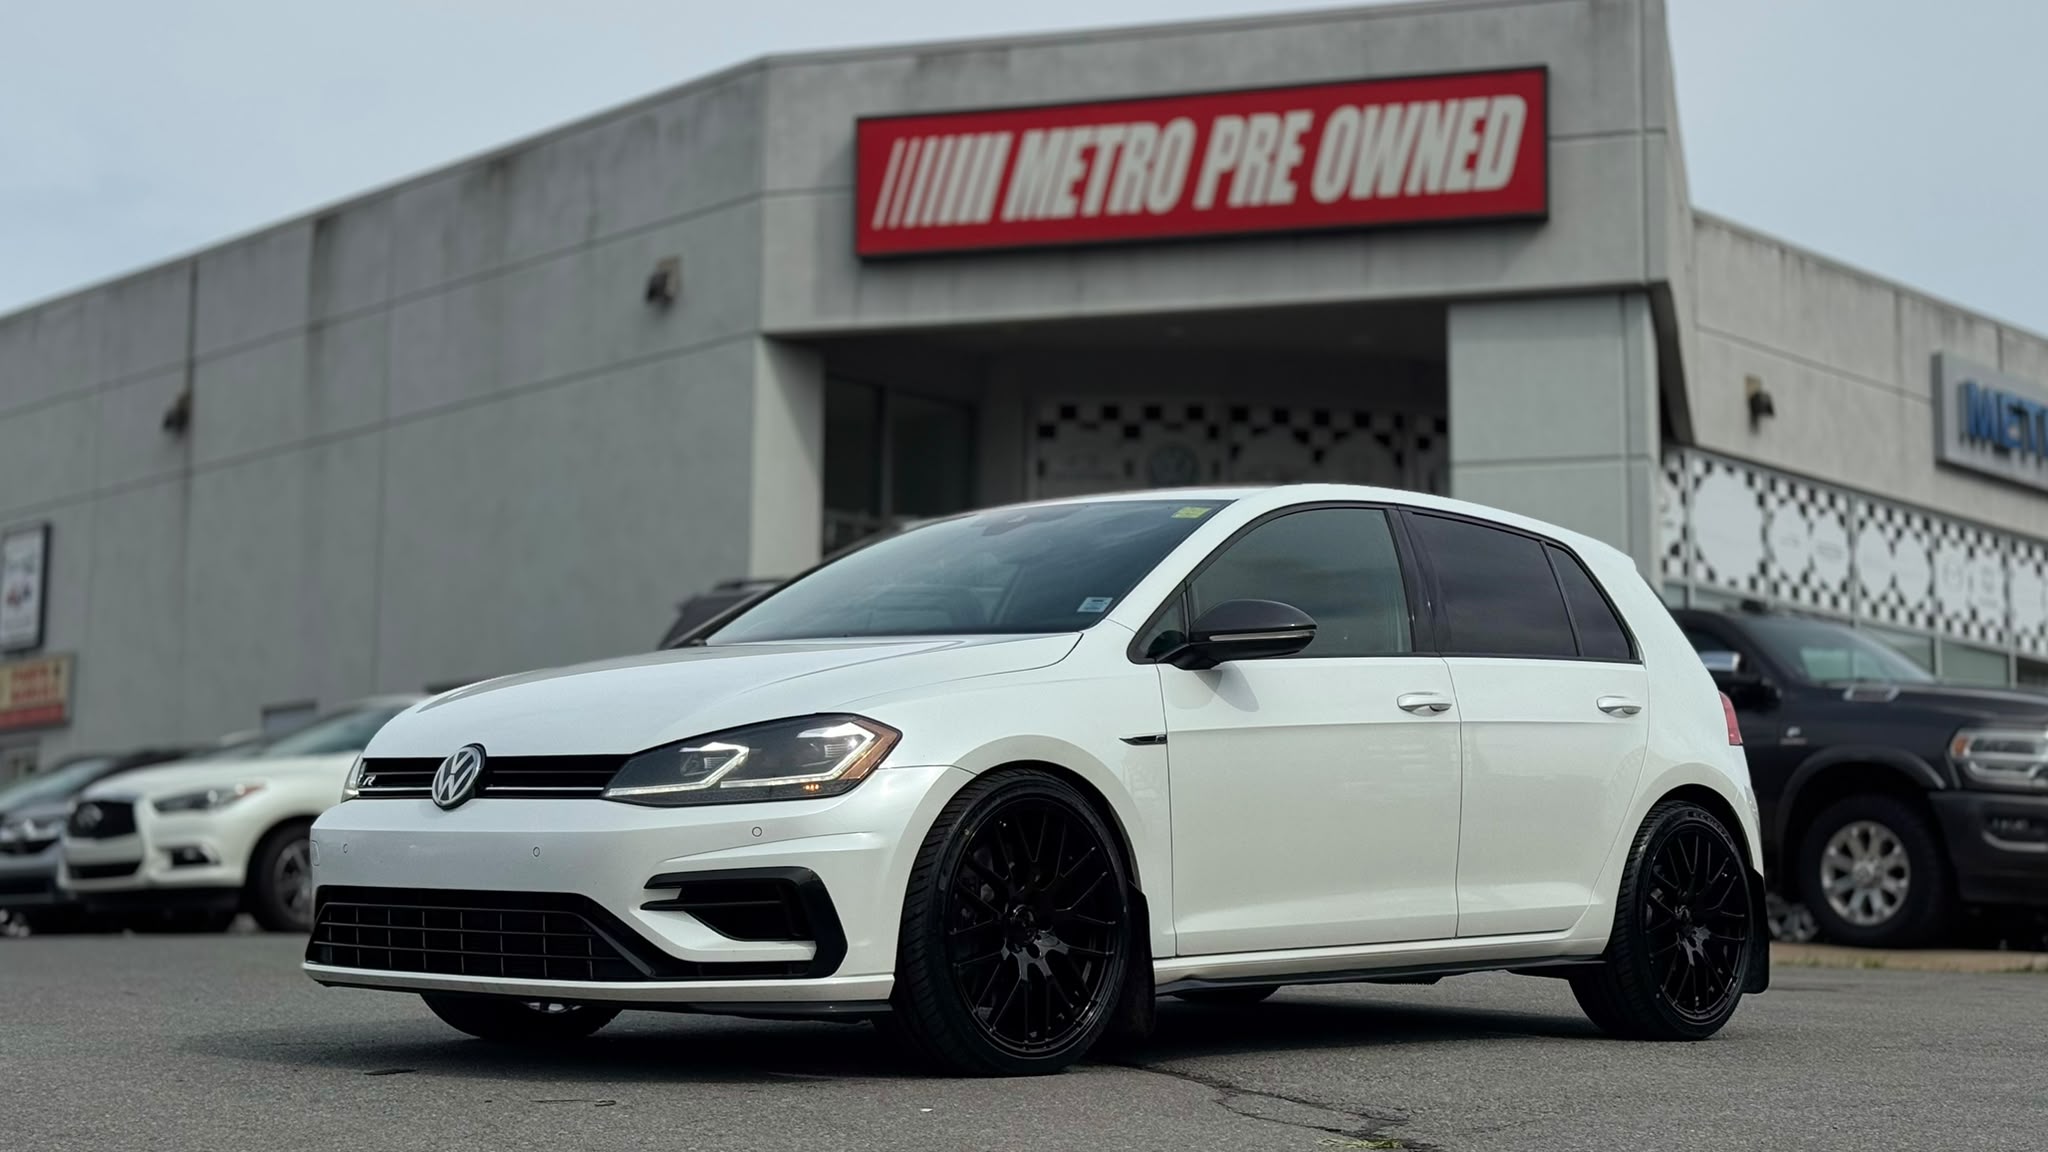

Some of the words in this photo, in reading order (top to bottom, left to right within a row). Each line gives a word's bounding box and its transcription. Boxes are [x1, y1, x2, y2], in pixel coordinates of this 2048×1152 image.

[1000, 117, 1197, 222] METRO
[1193, 109, 1314, 211] PRE
[1310, 95, 1527, 204] OWNED
